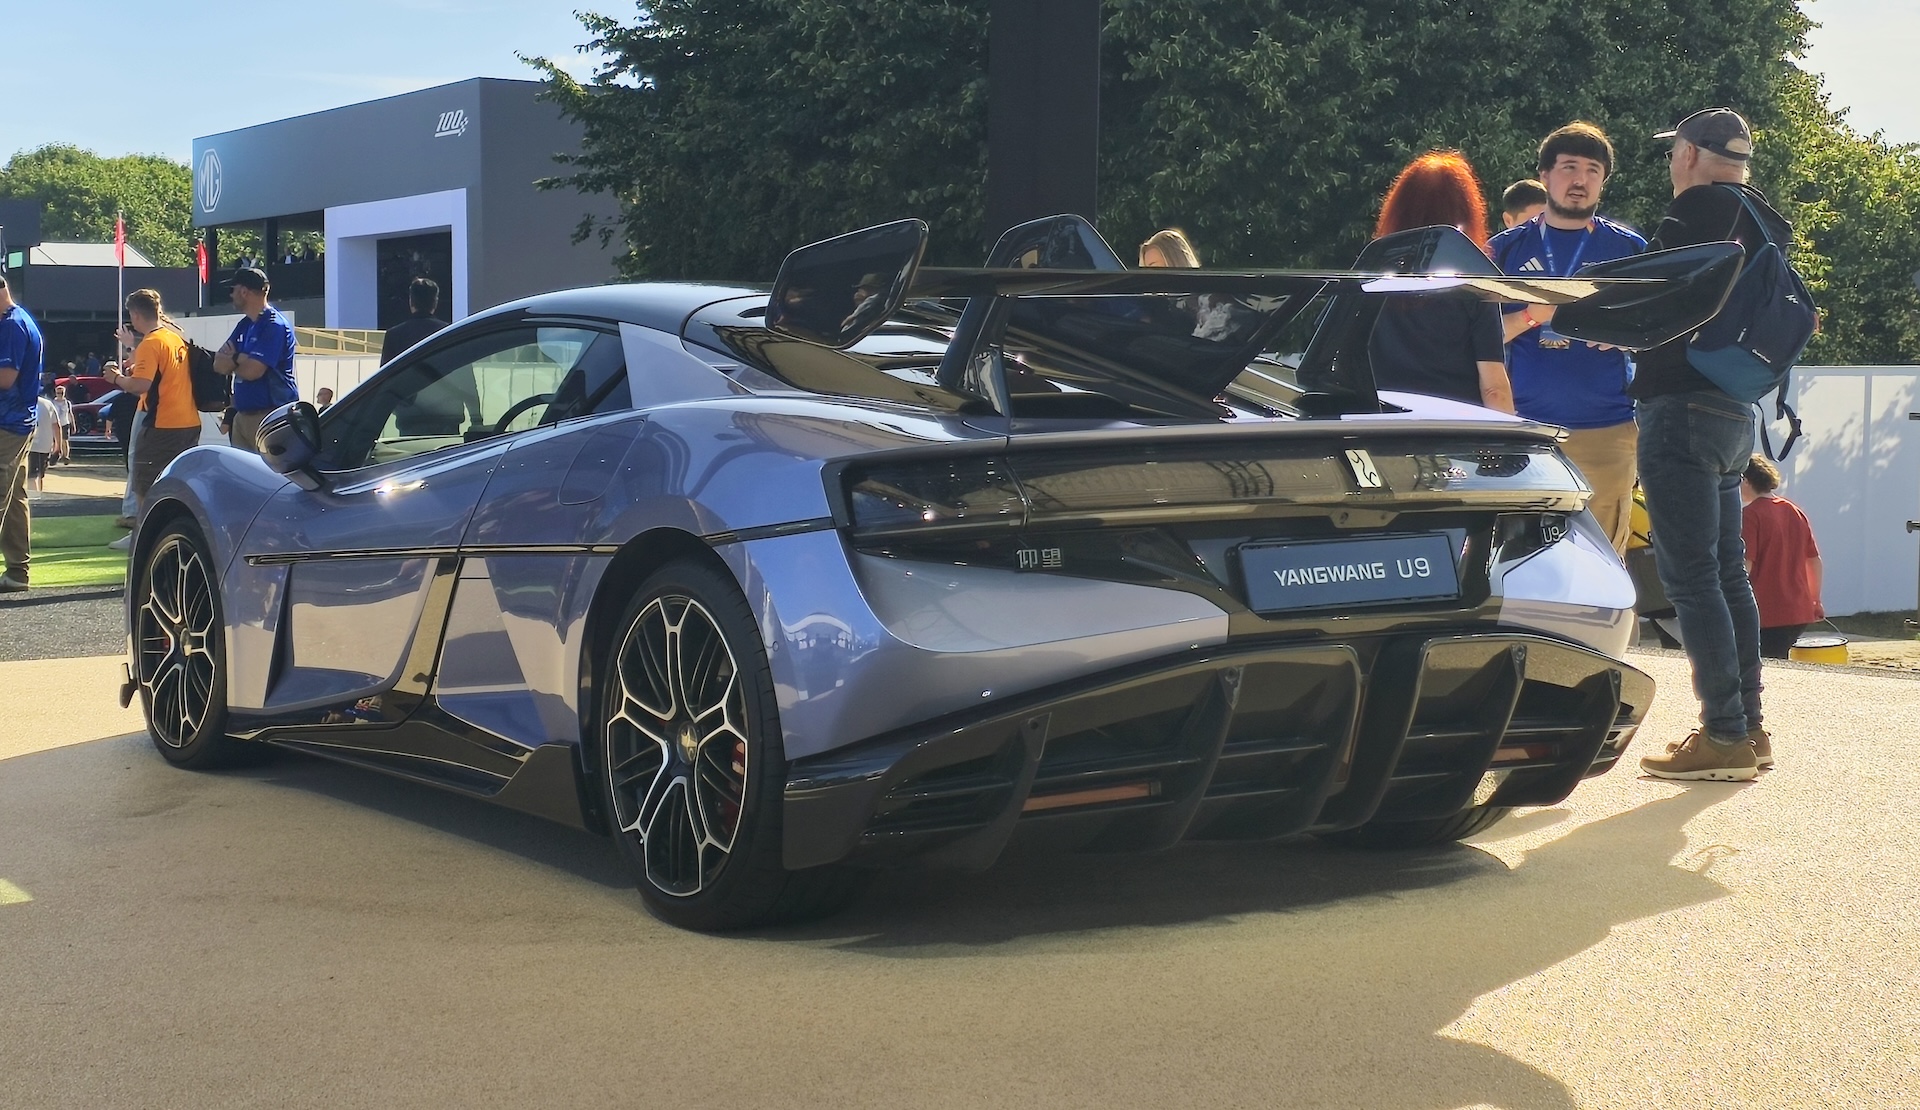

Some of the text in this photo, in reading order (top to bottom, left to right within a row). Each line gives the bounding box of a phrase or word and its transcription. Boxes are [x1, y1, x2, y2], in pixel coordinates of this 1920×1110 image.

[435, 109, 464, 132] 100
[200, 152, 220, 208] MG
[1542, 526, 1561, 542] U9
[1016, 548, 1062, 568] 仰望
[1273, 557, 1431, 587] YANGWANG U9
